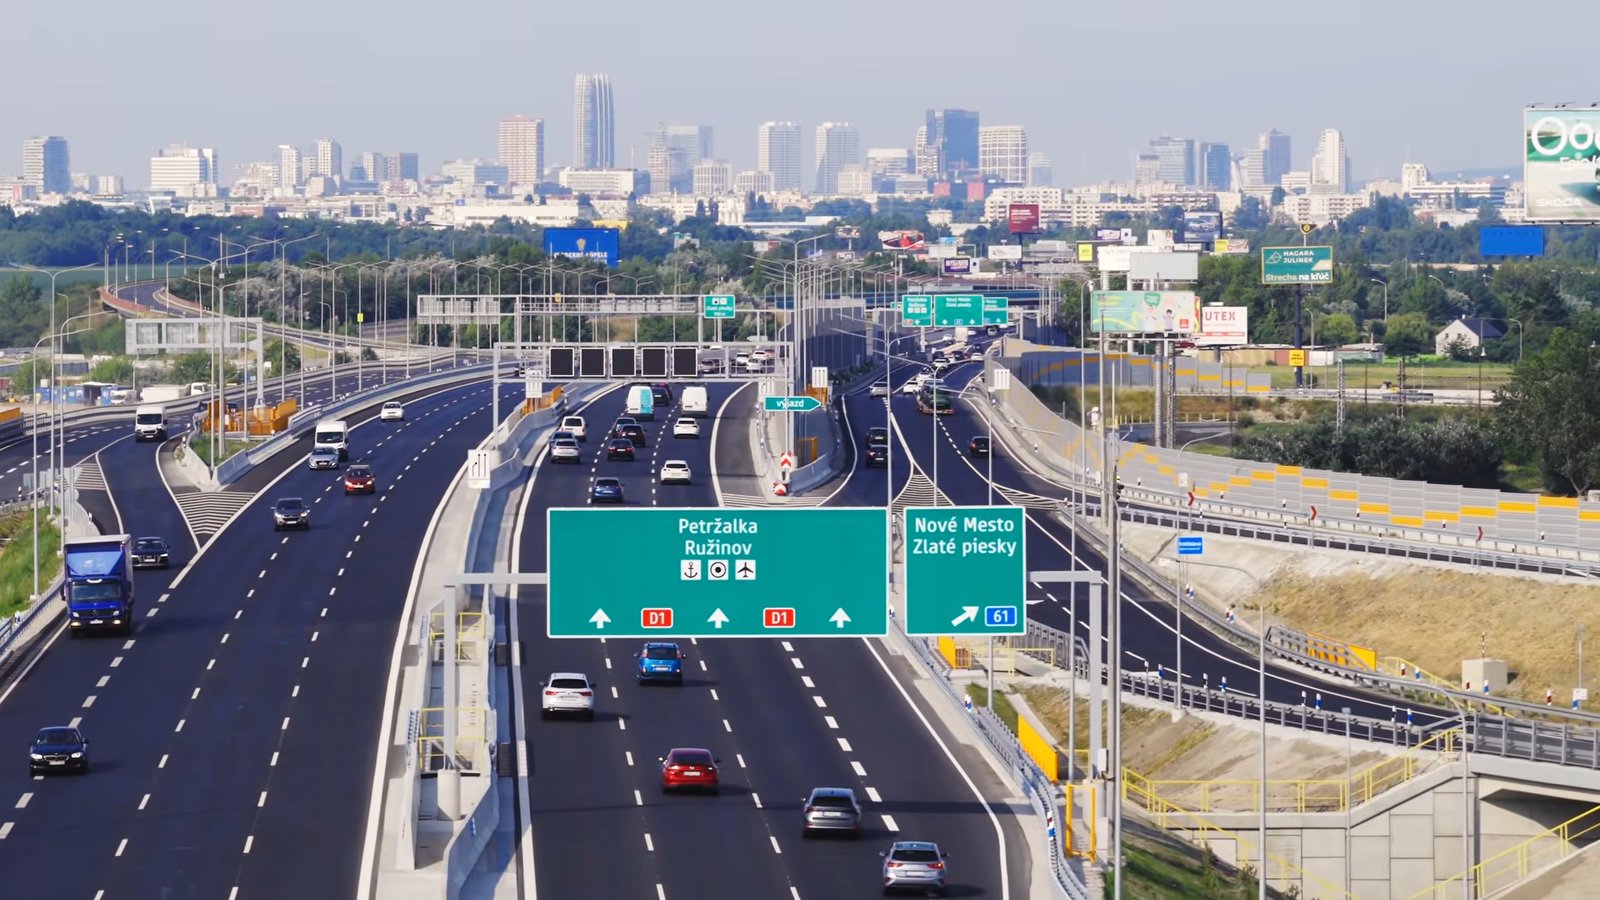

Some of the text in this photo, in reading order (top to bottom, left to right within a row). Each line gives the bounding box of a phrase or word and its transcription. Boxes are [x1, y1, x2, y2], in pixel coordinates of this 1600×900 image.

[1531, 116, 1600, 156] Oo
[1265, 273, 1297, 281] Strecha
[679, 518, 758, 534] Petržalka
[915, 516, 1014, 532] Nové Mesto
[685, 539, 752, 555] Ružinov
[913, 537, 1017, 557] Zlaté piesky
[649, 611, 665, 625] D1
[771, 611, 788, 625] D1
[993, 610, 1009, 623] 61
